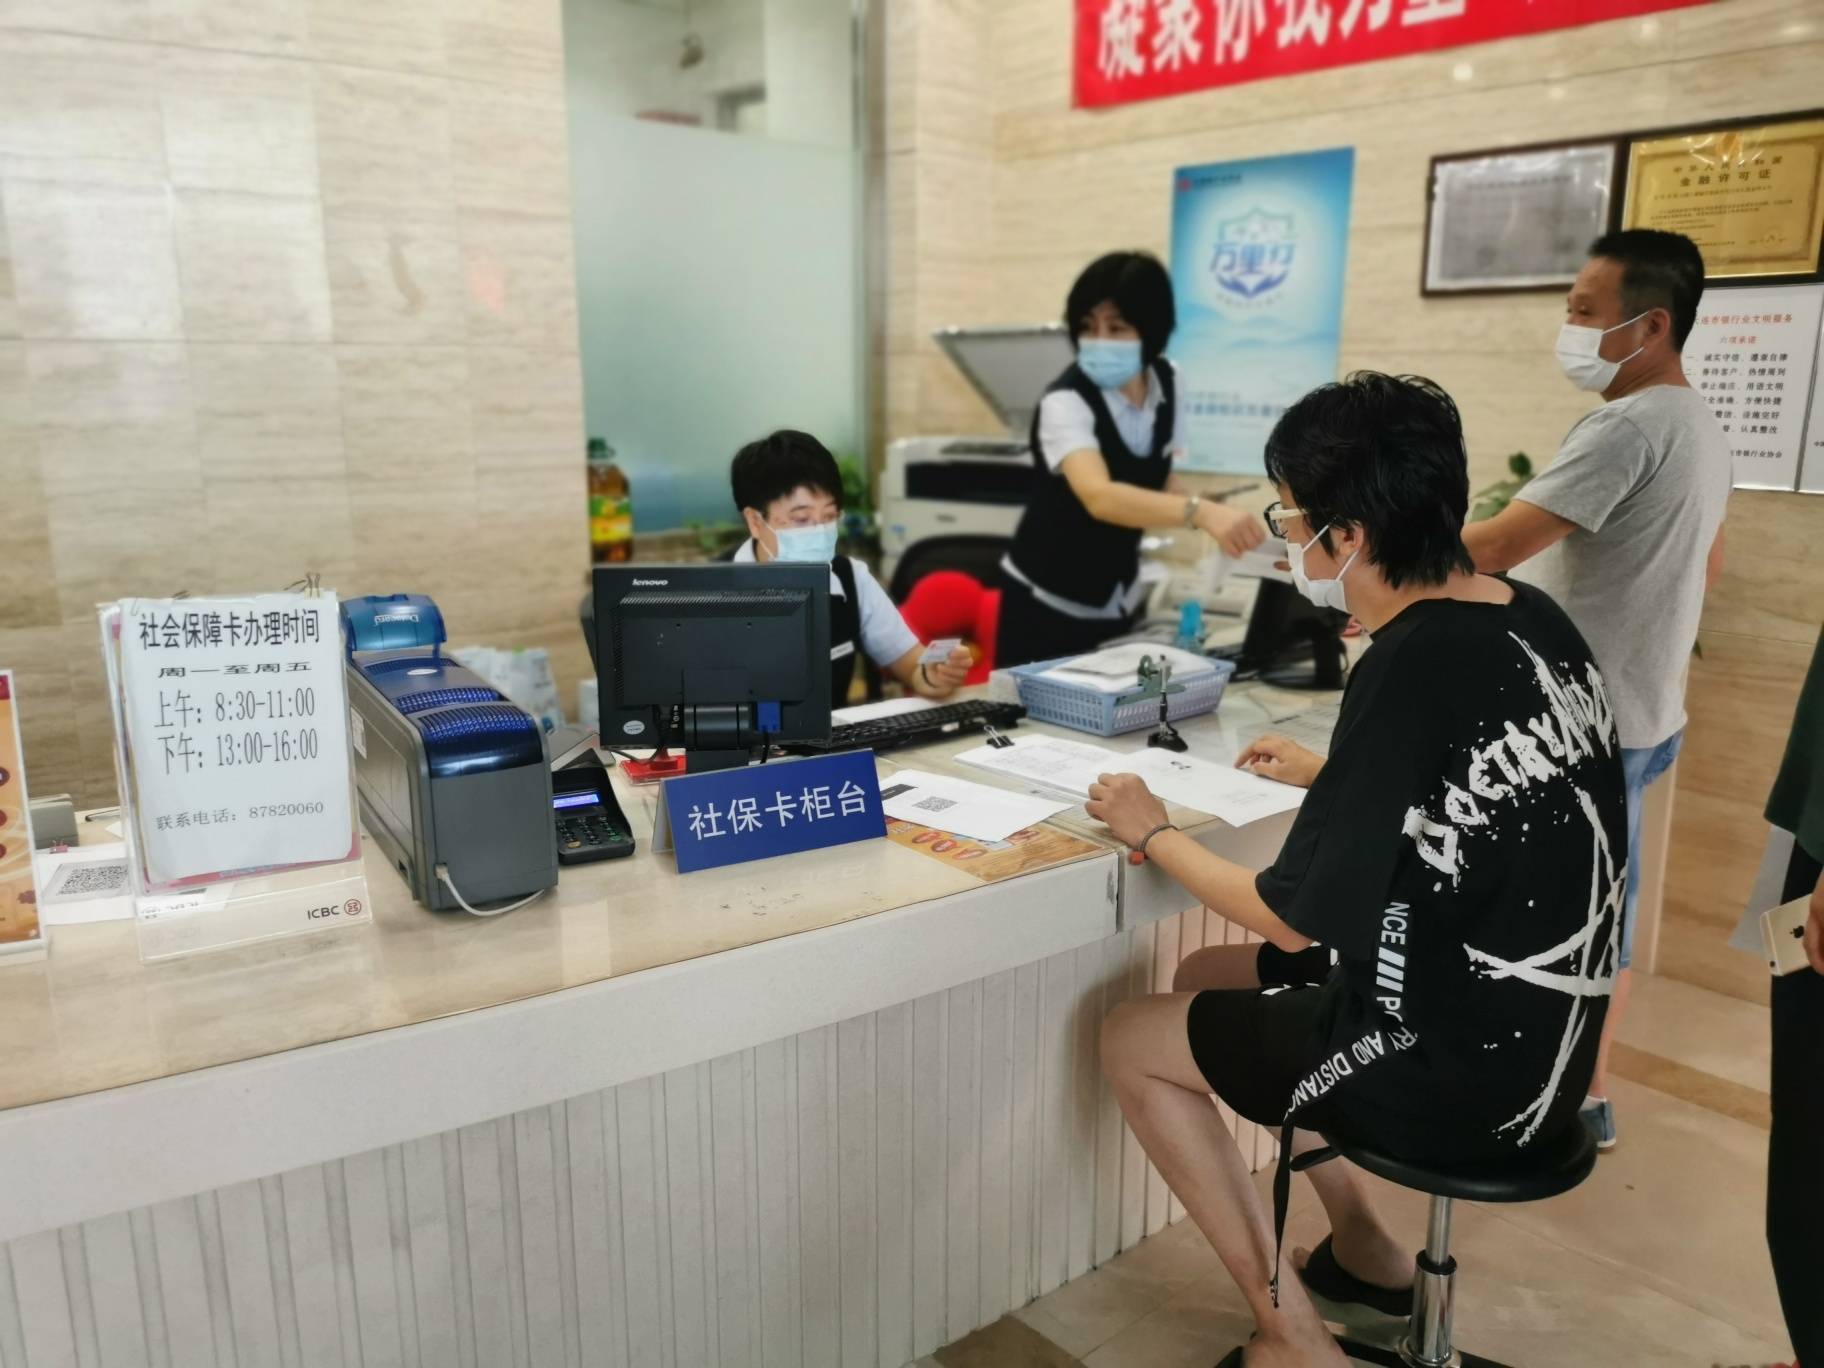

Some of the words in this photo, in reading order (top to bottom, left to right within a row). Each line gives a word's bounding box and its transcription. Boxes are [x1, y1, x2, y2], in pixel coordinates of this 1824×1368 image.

[632, 578, 668, 586] lenovo
[139, 608, 320, 650] 社会保障卡办理时间
[158, 661, 313, 679] 周一至周五
[687, 780, 867, 841] 社保卡柜台
[307, 906, 341, 920] ICBC
[1352, 1031, 1385, 1065] AND
